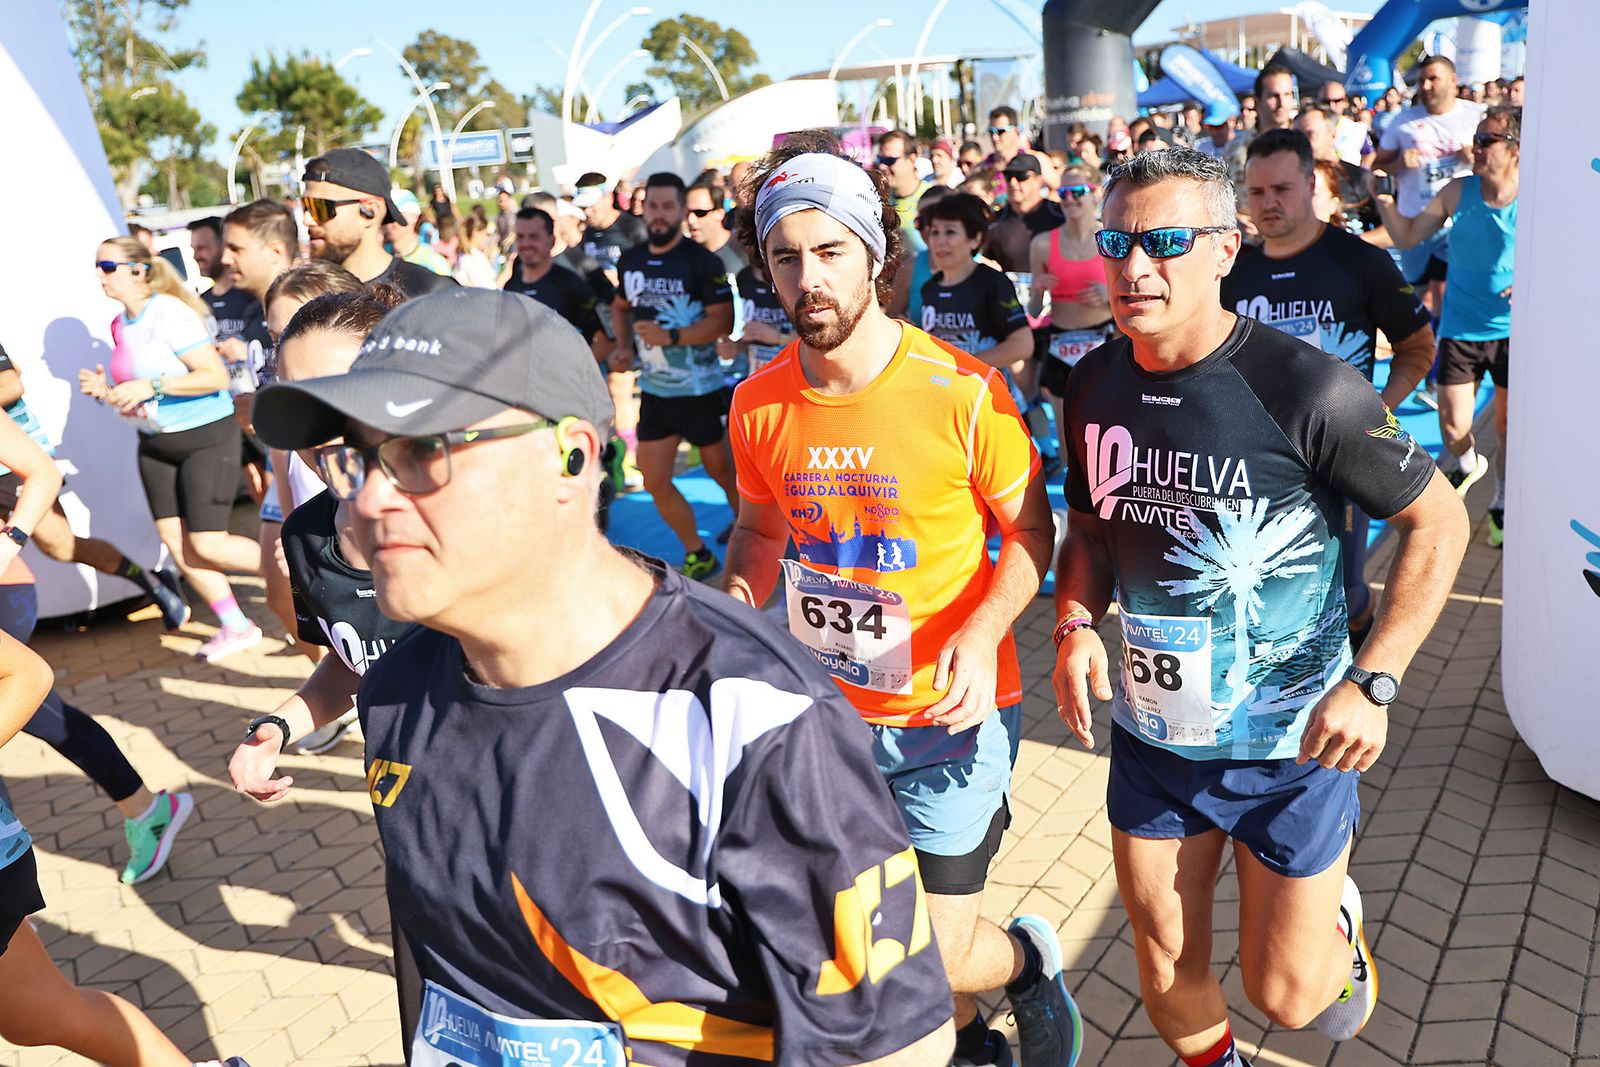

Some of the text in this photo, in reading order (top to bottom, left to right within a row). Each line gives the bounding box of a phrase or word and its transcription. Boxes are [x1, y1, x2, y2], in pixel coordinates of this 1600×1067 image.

[1269, 299, 1335, 322] HUELVA
[934, 312, 976, 329] HUELVA
[394, 336, 442, 356] bank
[807, 446, 875, 470] XXXV
[784, 472, 899, 484] CARRERA NOCTURNA
[1132, 446, 1253, 497] HUELVA
[790, 484, 899, 499] GUADALQUIVIR
[1132, 485, 1161, 500] PUERTA
[1161, 488, 1177, 502] DEL
[800, 574, 828, 585] HUELVA
[801, 595, 887, 640] 634
[1126, 623, 1168, 639] AVATEL
[445, 1011, 481, 1043] HUELVA
[484, 1032, 551, 1062] AVATEL
